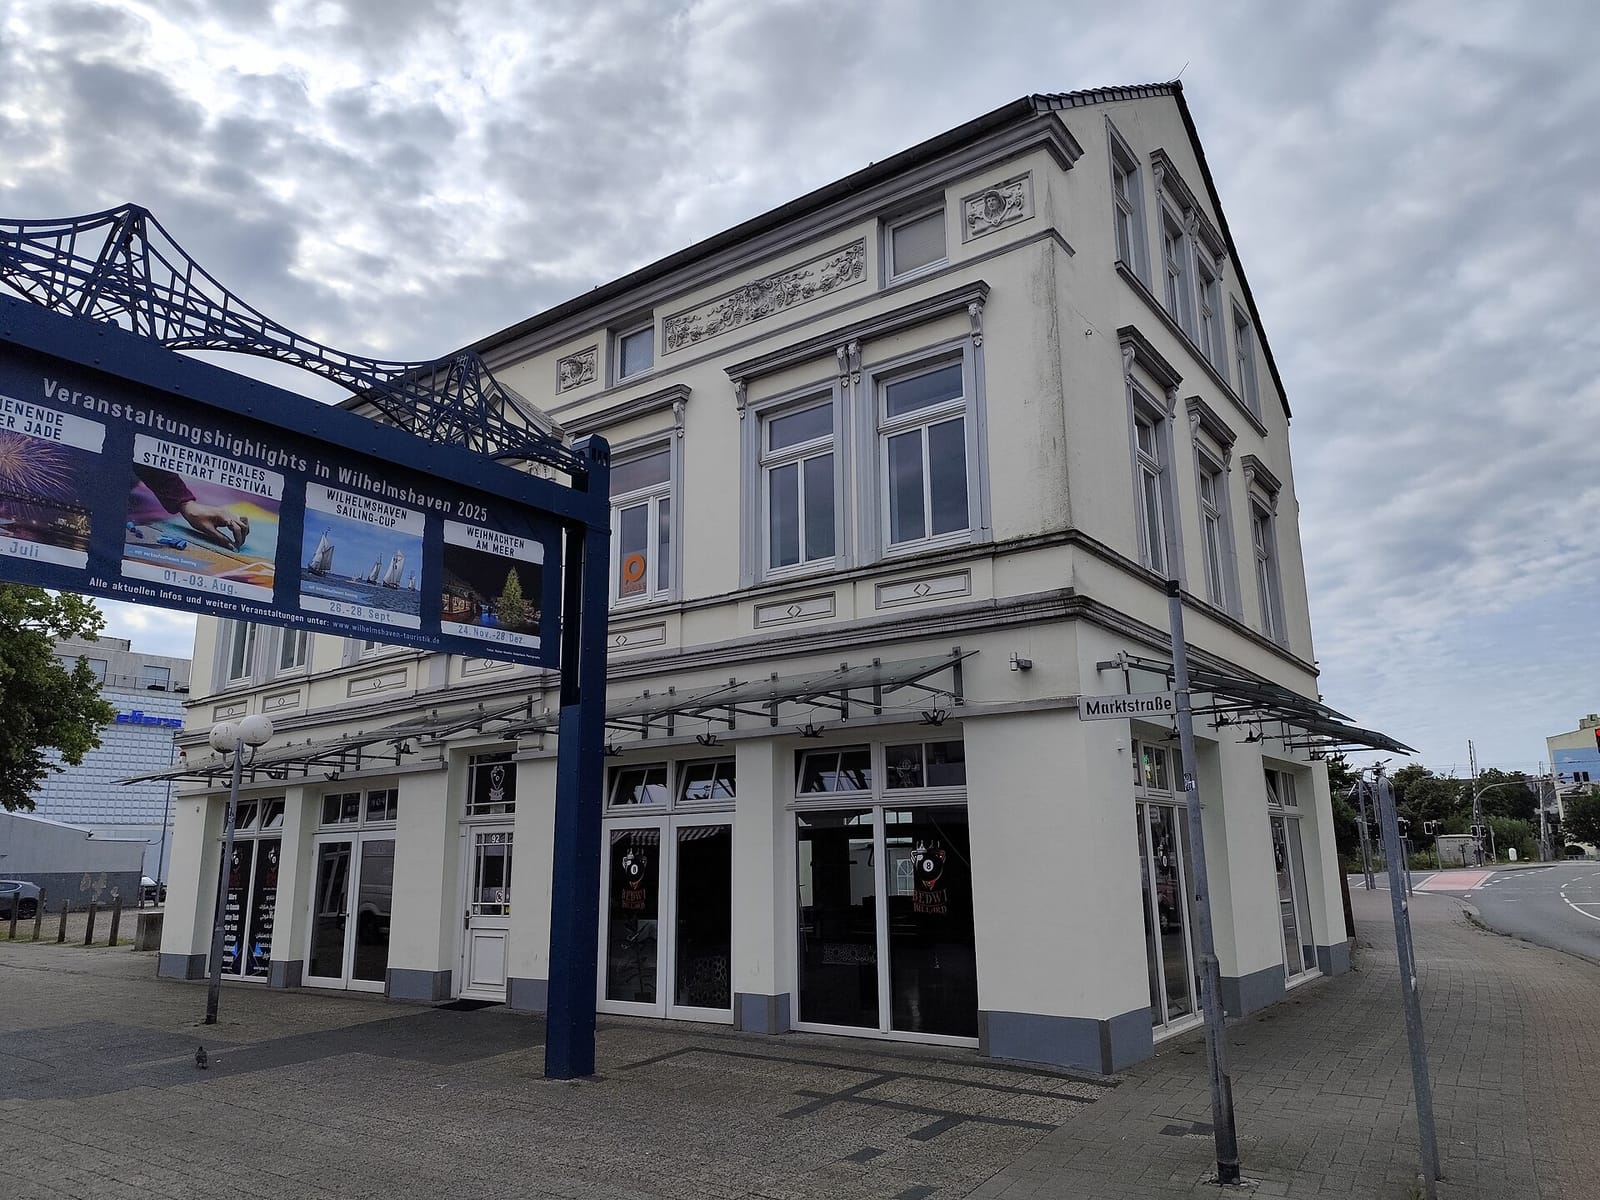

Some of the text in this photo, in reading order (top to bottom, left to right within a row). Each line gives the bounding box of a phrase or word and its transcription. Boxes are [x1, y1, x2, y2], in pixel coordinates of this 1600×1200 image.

[24, 420, 62, 441] JADE
[43, 378, 488, 522] Veranstaltungshighlights in Wilhelmshaven 2025
[156, 441, 266, 482] INTERNATIONALES
[143, 452, 273, 497] STREETART FESTIVAL
[326, 489, 408, 520] WILHELMSHAVEN
[336, 505, 396, 528] SAILING-CUP
[466, 526, 525, 549] WEIHNACHTEN
[476, 541, 515, 557] AM MEER
[9, 542, 39, 558] Juli
[163, 570, 238, 595] 01.-03. Aug.
[89, 577, 107, 588] Alle
[112, 582, 156, 597] aktuellen
[159, 589, 182, 602] Infos
[186, 595, 201, 605] und
[205, 599, 237, 611] weitere
[240, 603, 304, 622] Veranstaltungen
[306, 617, 330, 627] unter:
[368, 610, 394, 623] Sept.
[1086, 696, 1172, 715] Marktstraße
[491, 834, 500, 843] 92
